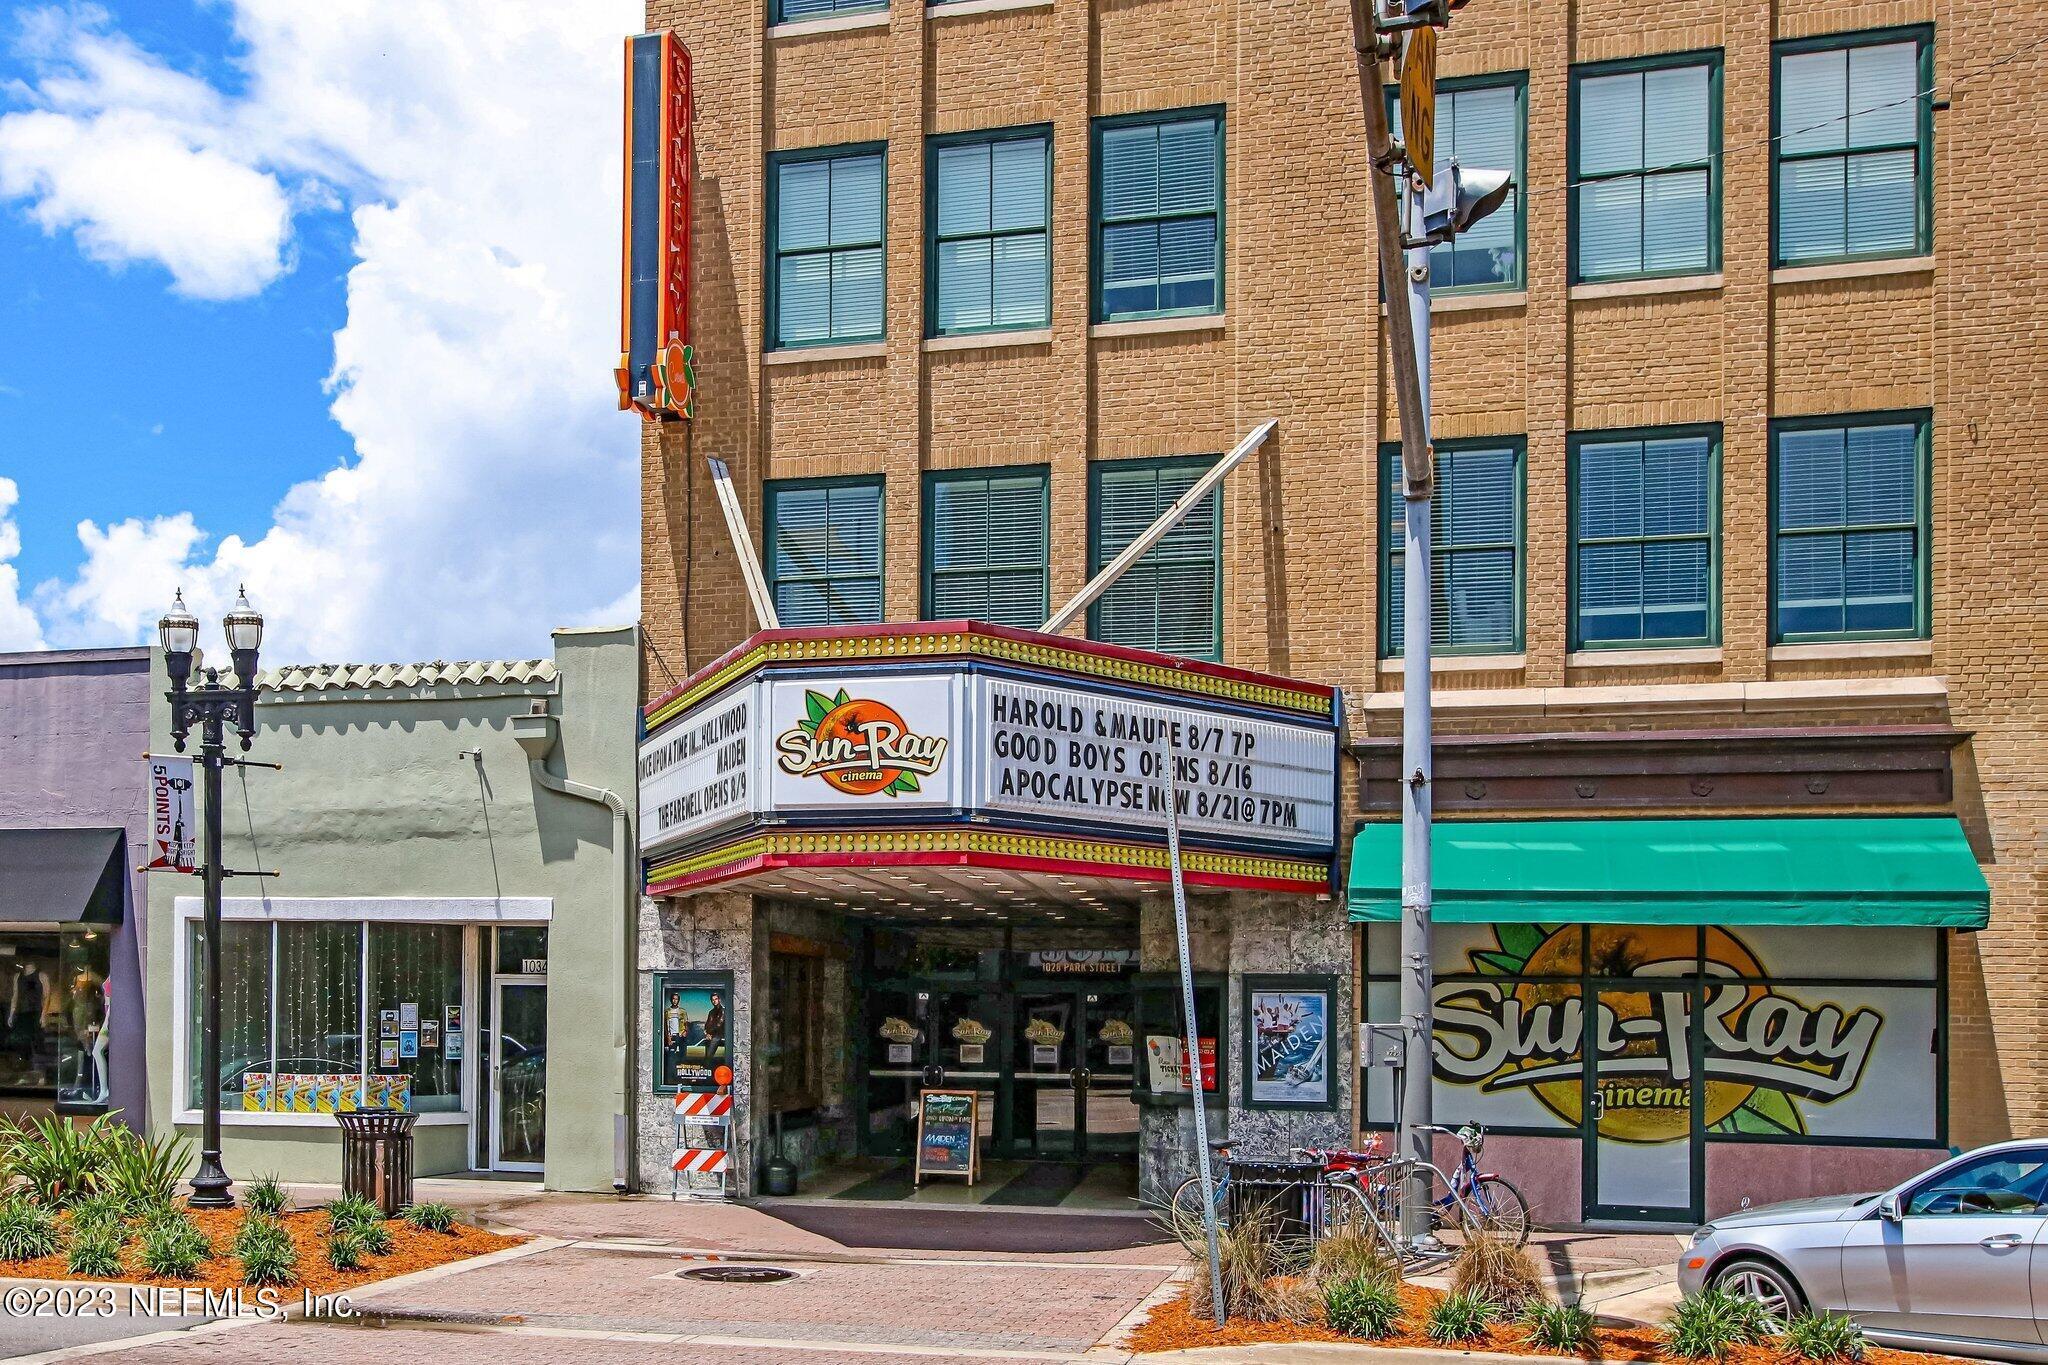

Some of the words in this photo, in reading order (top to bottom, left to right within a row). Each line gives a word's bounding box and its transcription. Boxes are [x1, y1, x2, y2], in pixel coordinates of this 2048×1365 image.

[653, 743, 668, 775] UPON
[673, 733, 688, 763] TIME
[702, 703, 747, 750] HOLLYWOOD
[776, 720, 948, 776] Sun-Ray
[993, 694, 1083, 733] HAROLD
[1188, 724, 1224, 753] 8/7
[1231, 731, 1255, 757] 7P
[716, 736, 747, 775] MAIDEN
[840, 770, 883, 783] cinema
[994, 730, 1057, 765] GOOD
[1069, 740, 1126, 773] BOYS
[1208, 759, 1253, 790] 8/16
[658, 802, 670, 831] THE
[669, 789, 703, 827] FAREWELL
[704, 780, 729, 812] OPENS
[730, 771, 747, 802] 8/9
[1000, 767, 1144, 810] APOCALYPSE
[1063, 962, 1086, 973] PARK
[1089, 962, 1121, 973] STREET
[677, 1068, 712, 1077] HOLLYWOOD
[1255, 1015, 1324, 1075] MAIDEN
